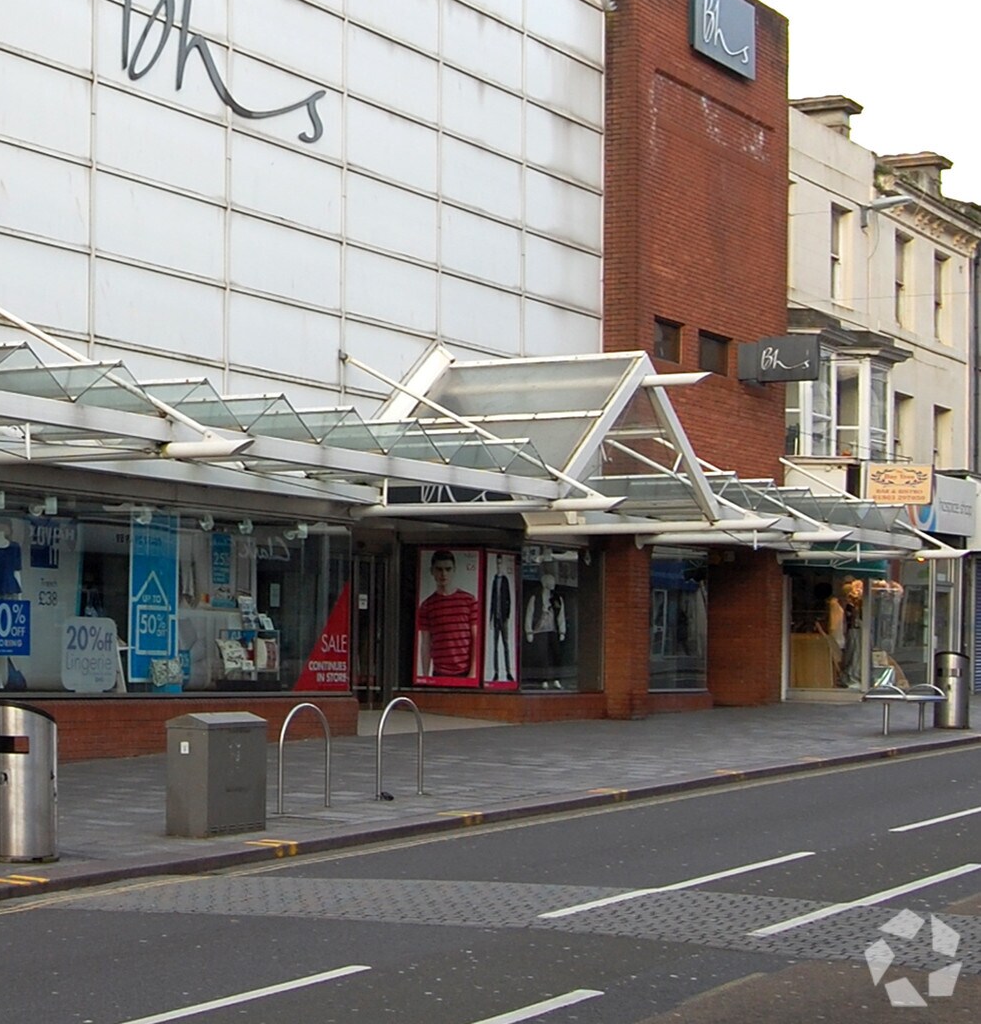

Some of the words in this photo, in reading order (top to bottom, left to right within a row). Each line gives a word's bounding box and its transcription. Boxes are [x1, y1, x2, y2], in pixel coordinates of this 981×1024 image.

[760, 346, 811, 371] Bhs
[38, 591, 58, 607] £38
[141, 594, 152, 603] UP
[152, 594, 162, 603] TO
[10, 626, 26, 638] OFF
[321, 633, 348, 653] SALE
[308, 660, 347, 672] CONTINUES
[316, 672, 325, 683] IN
[326, 672, 347, 683] STORE
